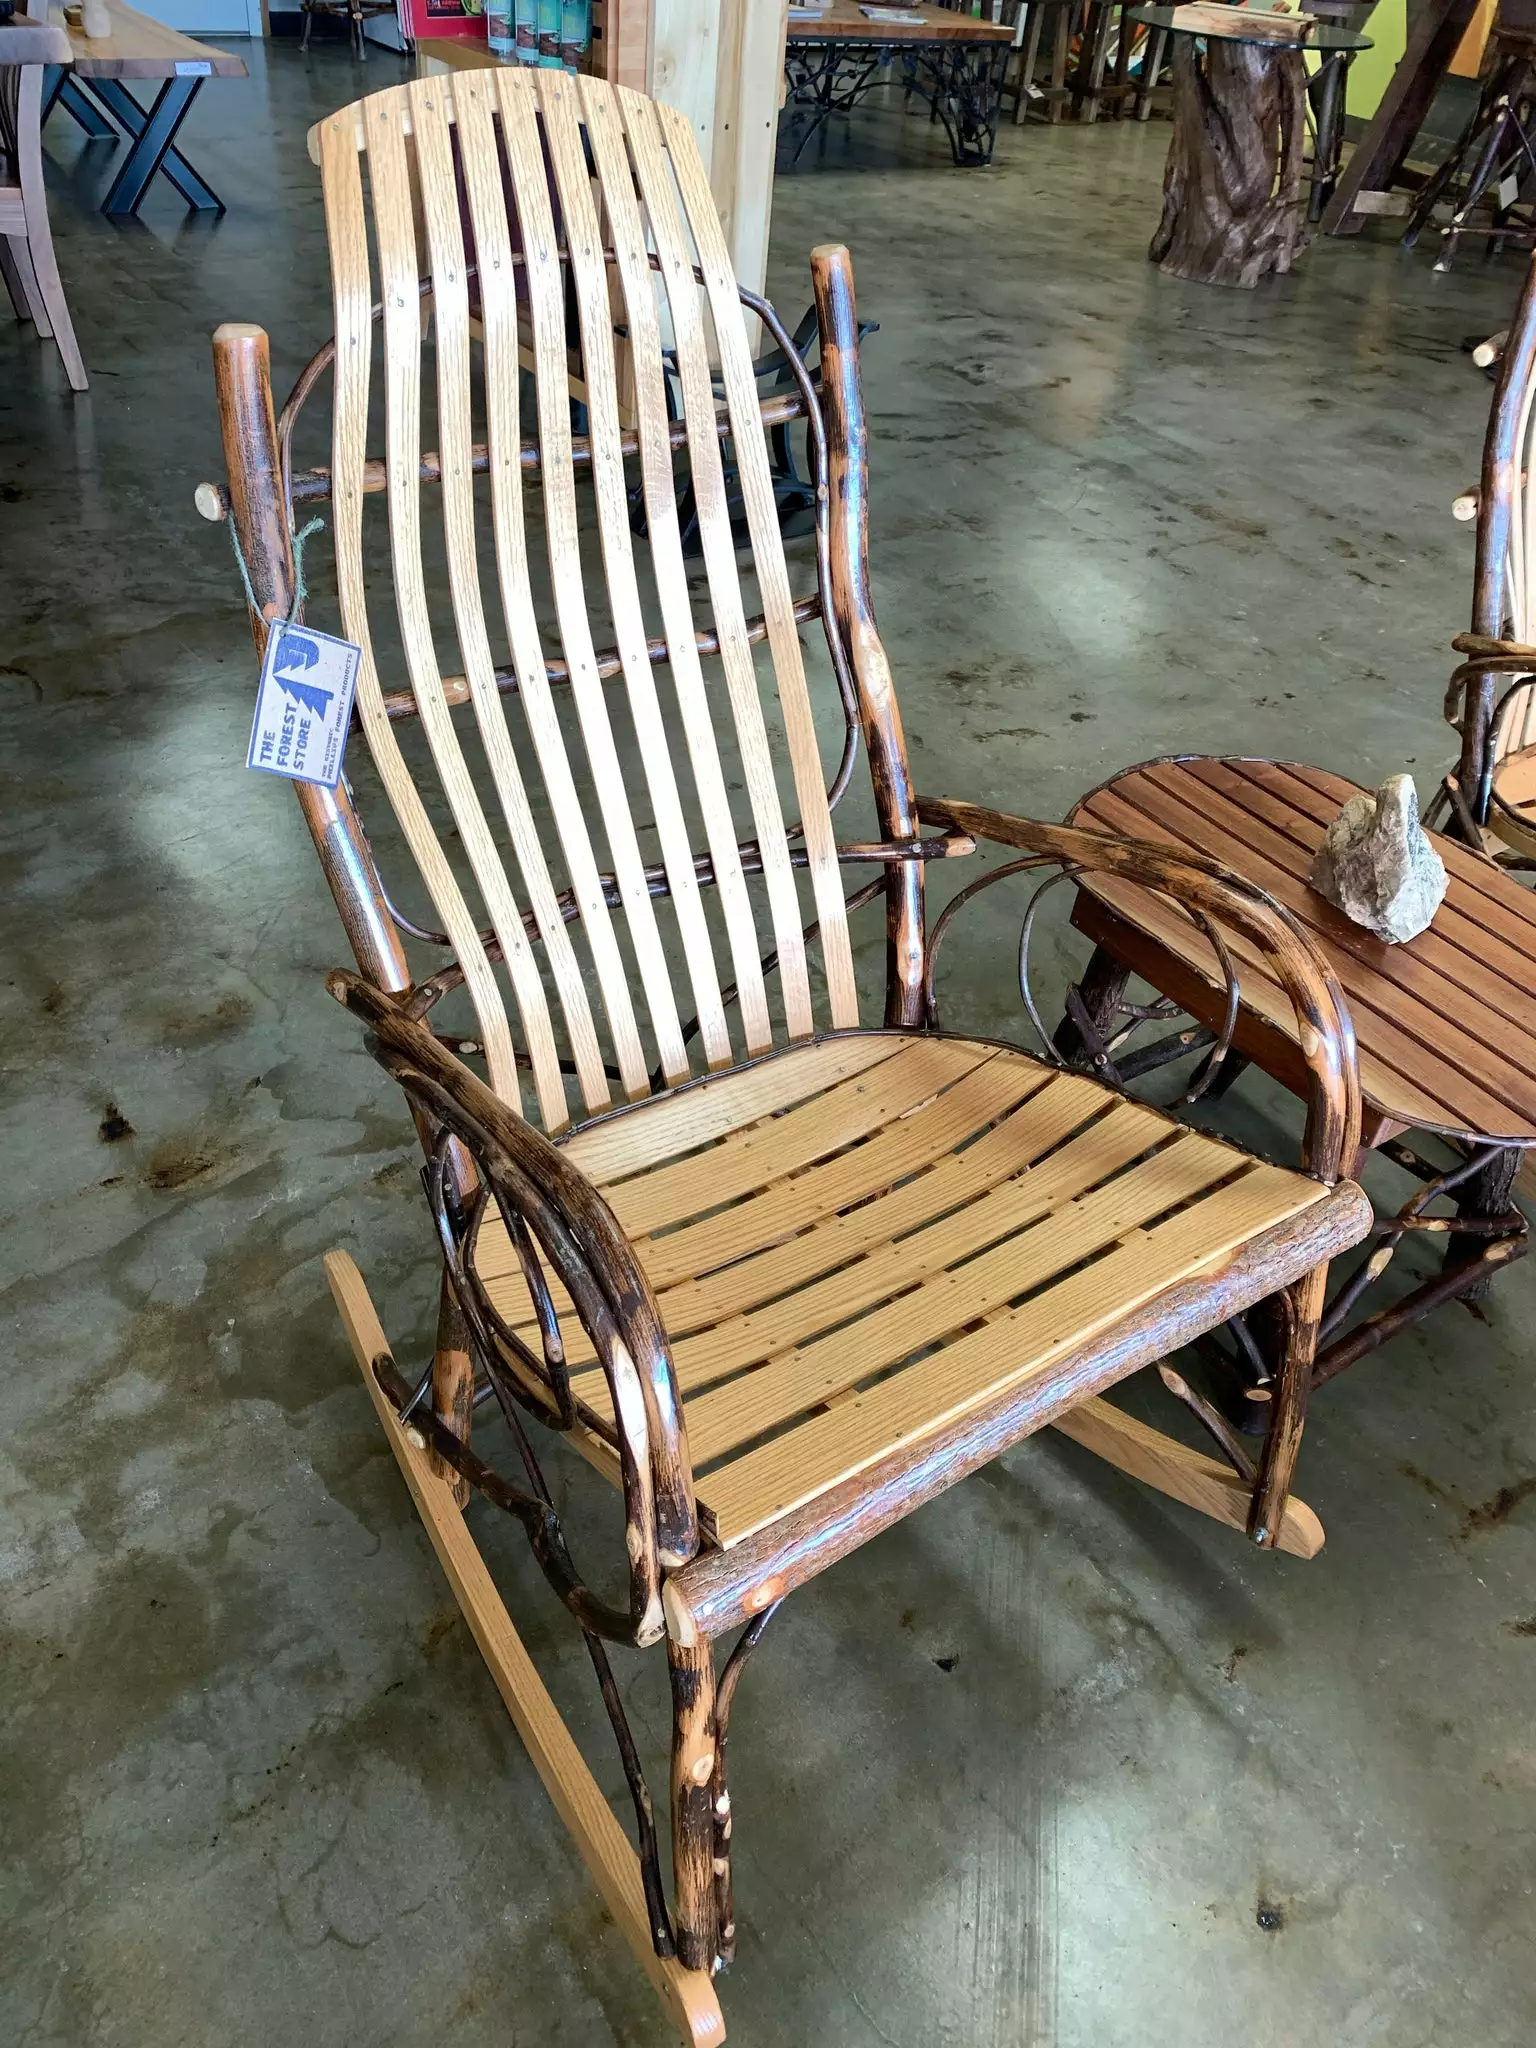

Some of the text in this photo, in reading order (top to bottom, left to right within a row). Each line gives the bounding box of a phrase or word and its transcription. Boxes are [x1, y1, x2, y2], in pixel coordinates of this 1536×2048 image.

[335, 700, 345, 733] FOREST
[341, 653, 353, 696] PRODUCTS
[259, 730, 275, 763] THE
[276, 703, 297, 767] FOREST
[293, 718, 312, 771] STORE
